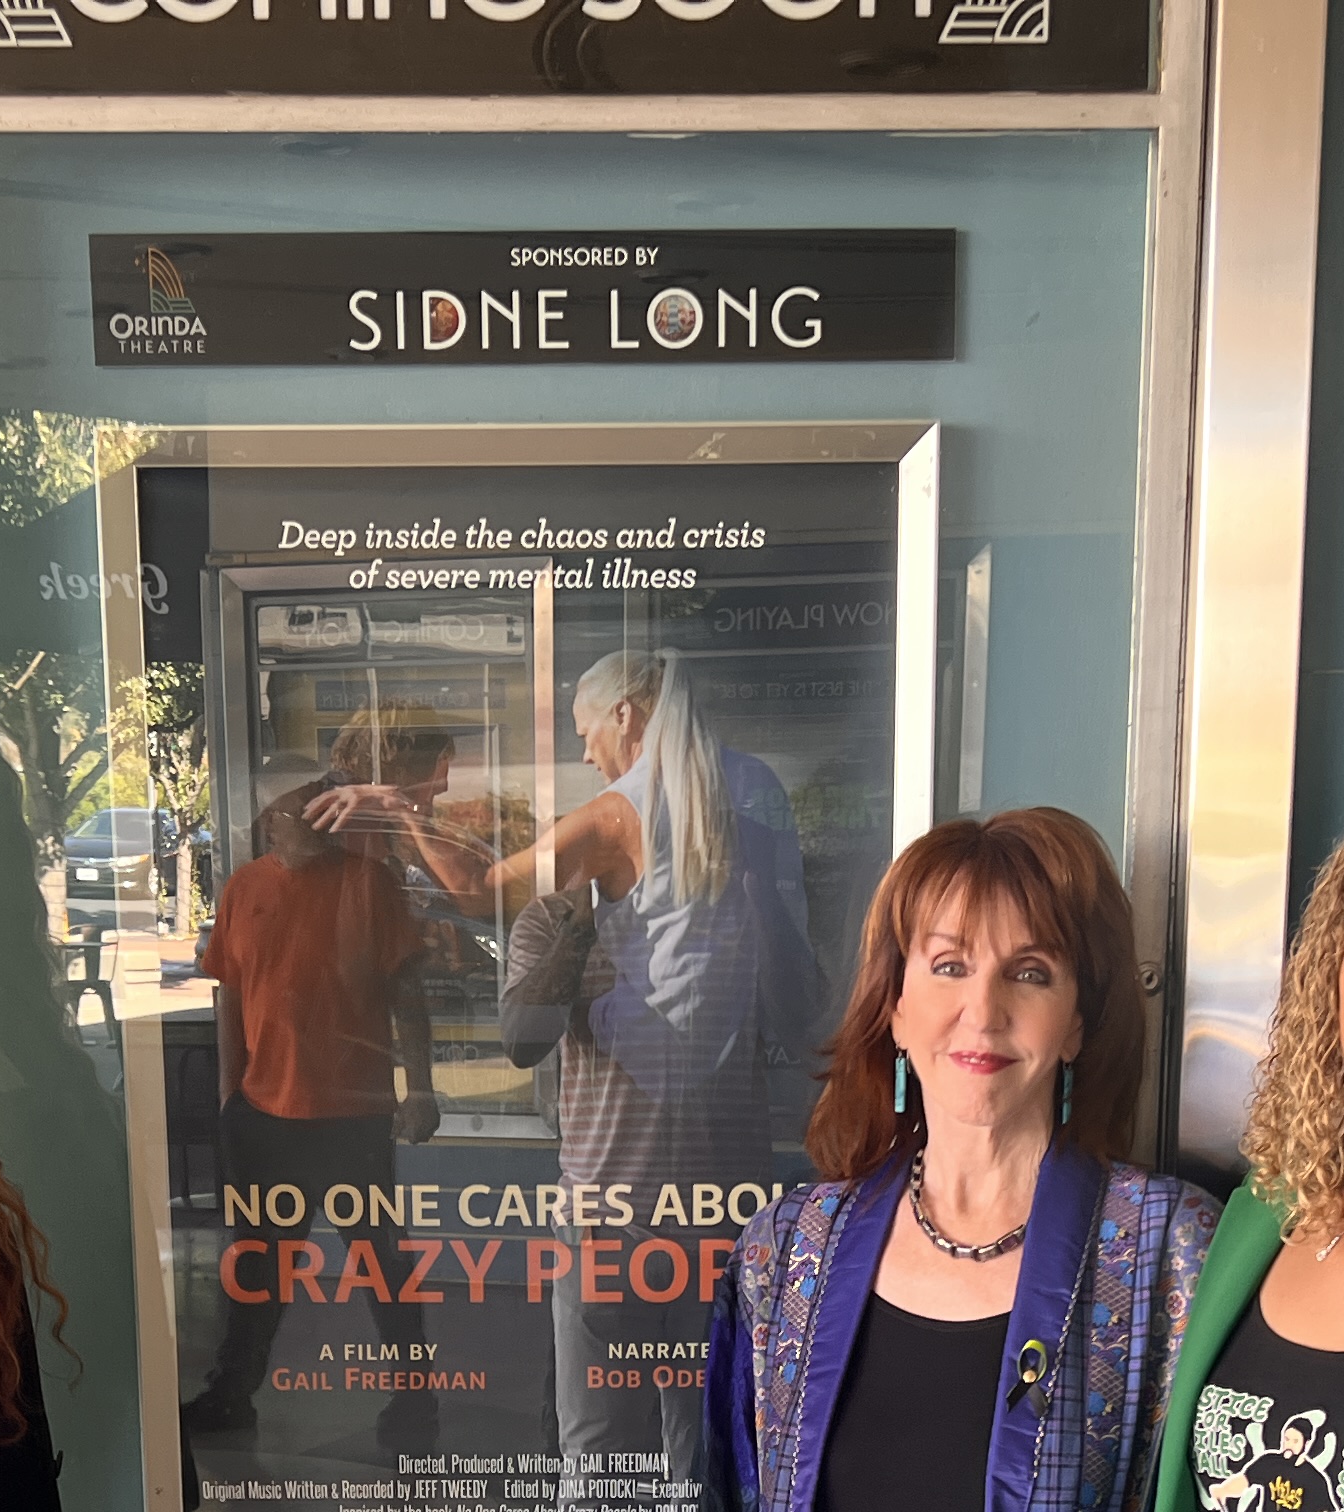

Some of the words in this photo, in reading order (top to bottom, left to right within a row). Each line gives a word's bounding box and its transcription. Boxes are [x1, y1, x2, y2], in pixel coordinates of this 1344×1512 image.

[510, 247, 628, 267] SPONSORED
[635, 246, 659, 266] BY
[109, 313, 207, 339] ORINDA
[348, 288, 568, 353] SIDNE
[608, 286, 824, 350] LONG
[118, 340, 206, 354] THEATRE
[278, 520, 357, 556] Deep
[365, 518, 457, 549] inside
[465, 519, 513, 549] the
[521, 518, 608, 549] chaos
[616, 518, 677, 549] and
[682, 520, 765, 548] crisis
[349, 558, 382, 590] of
[385, 564, 481, 589] severe
[488, 557, 593, 589] mental
[601, 557, 697, 589] illness
[224, 1183, 306, 1227] NO
[324, 1183, 440, 1227] ONE
[458, 1183, 633, 1227] CARES
[650, 1182, 807, 1227] ABO
[219, 1238, 502, 1304] CRAZY
[319, 1344, 334, 1361] A
[344, 1343, 400, 1361] FILM
[409, 1343, 438, 1361] BY
[1194, 1427, 1247, 1462] ILES
[399, 1453, 449, 1475] Directed,
[451, 1453, 504, 1474] Produced
[507, 1456, 515, 1474] &
[518, 1453, 560, 1474] Written
[563, 1453, 577, 1476] by
[580, 1452, 605, 1474] GAIL
[608, 1452, 669, 1474] FREEDMAN
[202, 1480, 245, 1502] Original
[248, 1480, 282, 1500] Music
[285, 1480, 328, 1500] Written
[331, 1482, 339, 1500] &
[342, 1479, 394, 1500] Recorded
[397, 1479, 410, 1501] by
[414, 1479, 437, 1500] JEFF
[441, 1479, 488, 1499] TWEEDY
[505, 1479, 539, 1499] Edited
[542, 1479, 556, 1501] by
[559, 1479, 585, 1499] DINA
[588, 1478, 636, 1499] POTOCKI
[652, 1478, 703, 1499] Executiv
